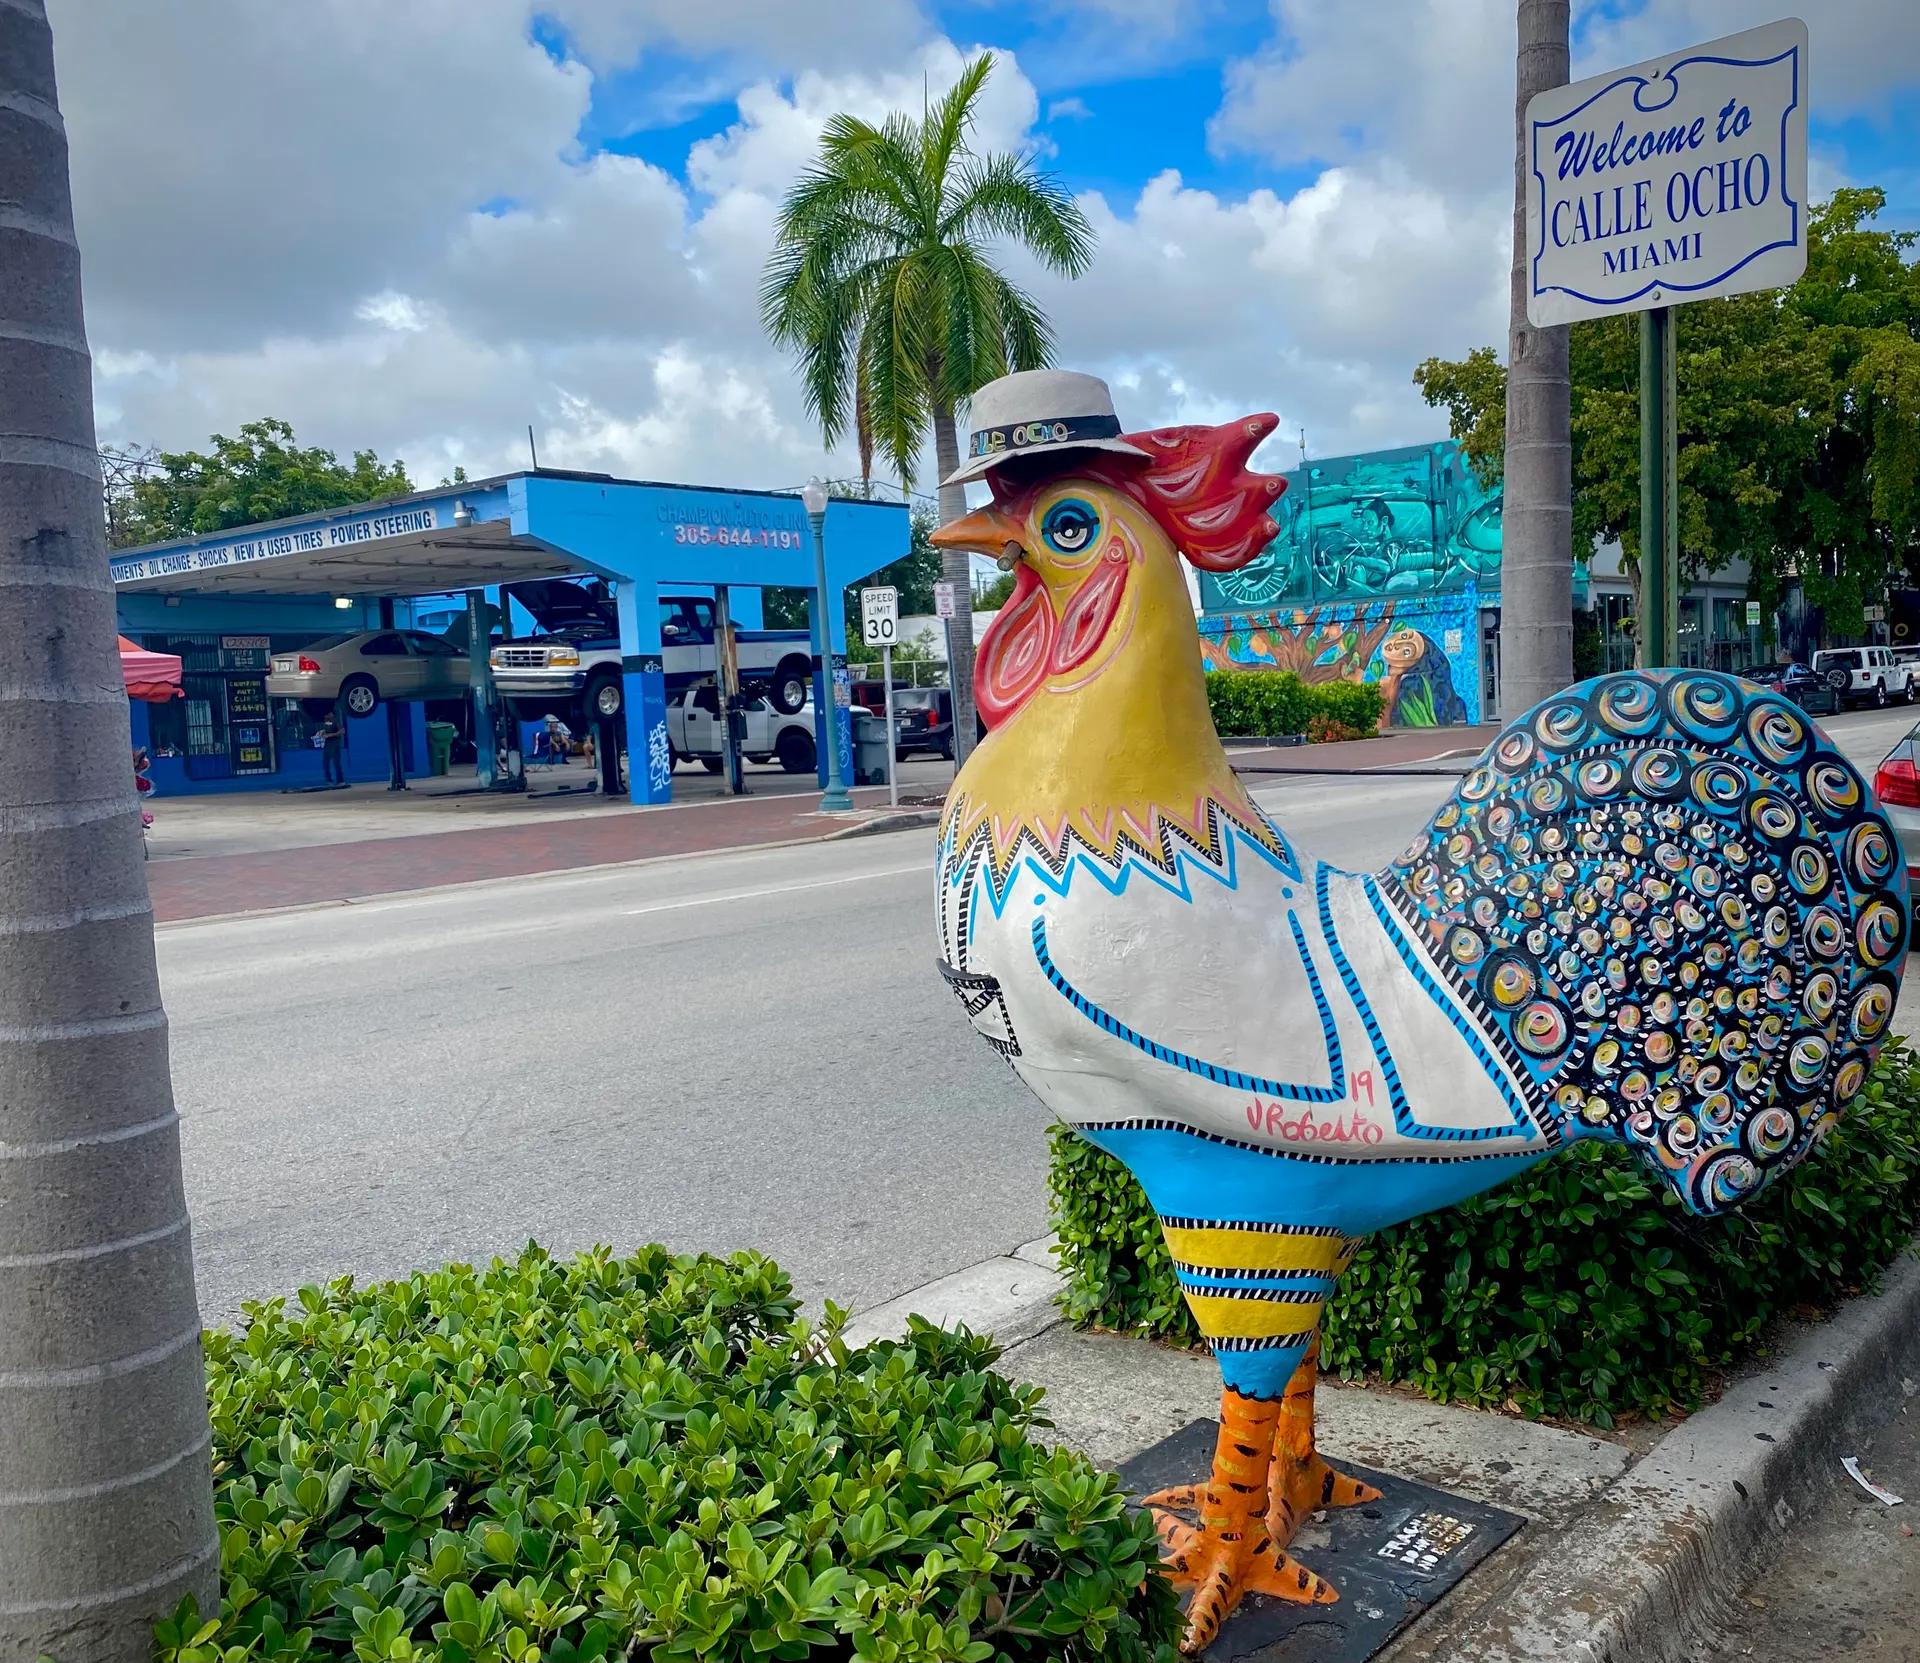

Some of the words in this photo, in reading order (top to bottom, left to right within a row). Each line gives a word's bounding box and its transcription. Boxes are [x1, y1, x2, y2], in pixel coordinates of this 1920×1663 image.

[1554, 116, 1705, 181] Welcome
[1715, 98, 1752, 144] to
[1551, 179, 1653, 248] CALLE
[1666, 153, 1770, 223] OCHO
[1602, 232, 1703, 277] MIAMI
[1013, 422, 1069, 446] OCHO
[657, 503, 730, 526] CHAMPION
[735, 507, 769, 529] AUTO
[149, 560, 161, 576] OIL
[162, 554, 191, 573] CHANGE
[199, 548, 228, 568] SHOCKS
[234, 544, 255, 561] NEW
[258, 543, 264, 556] &
[267, 535, 292, 556] USED
[293, 530, 323, 550] TIRES
[330, 522, 371, 545] POWER
[375, 511, 432, 537] STEERING
[674, 525, 801, 550] 305-644-1191
[865, 593, 894, 604] SPEED
[869, 606, 891, 615] LIMIT
[867, 618, 894, 639] 30
[1351, 1070, 1375, 1107] 19
